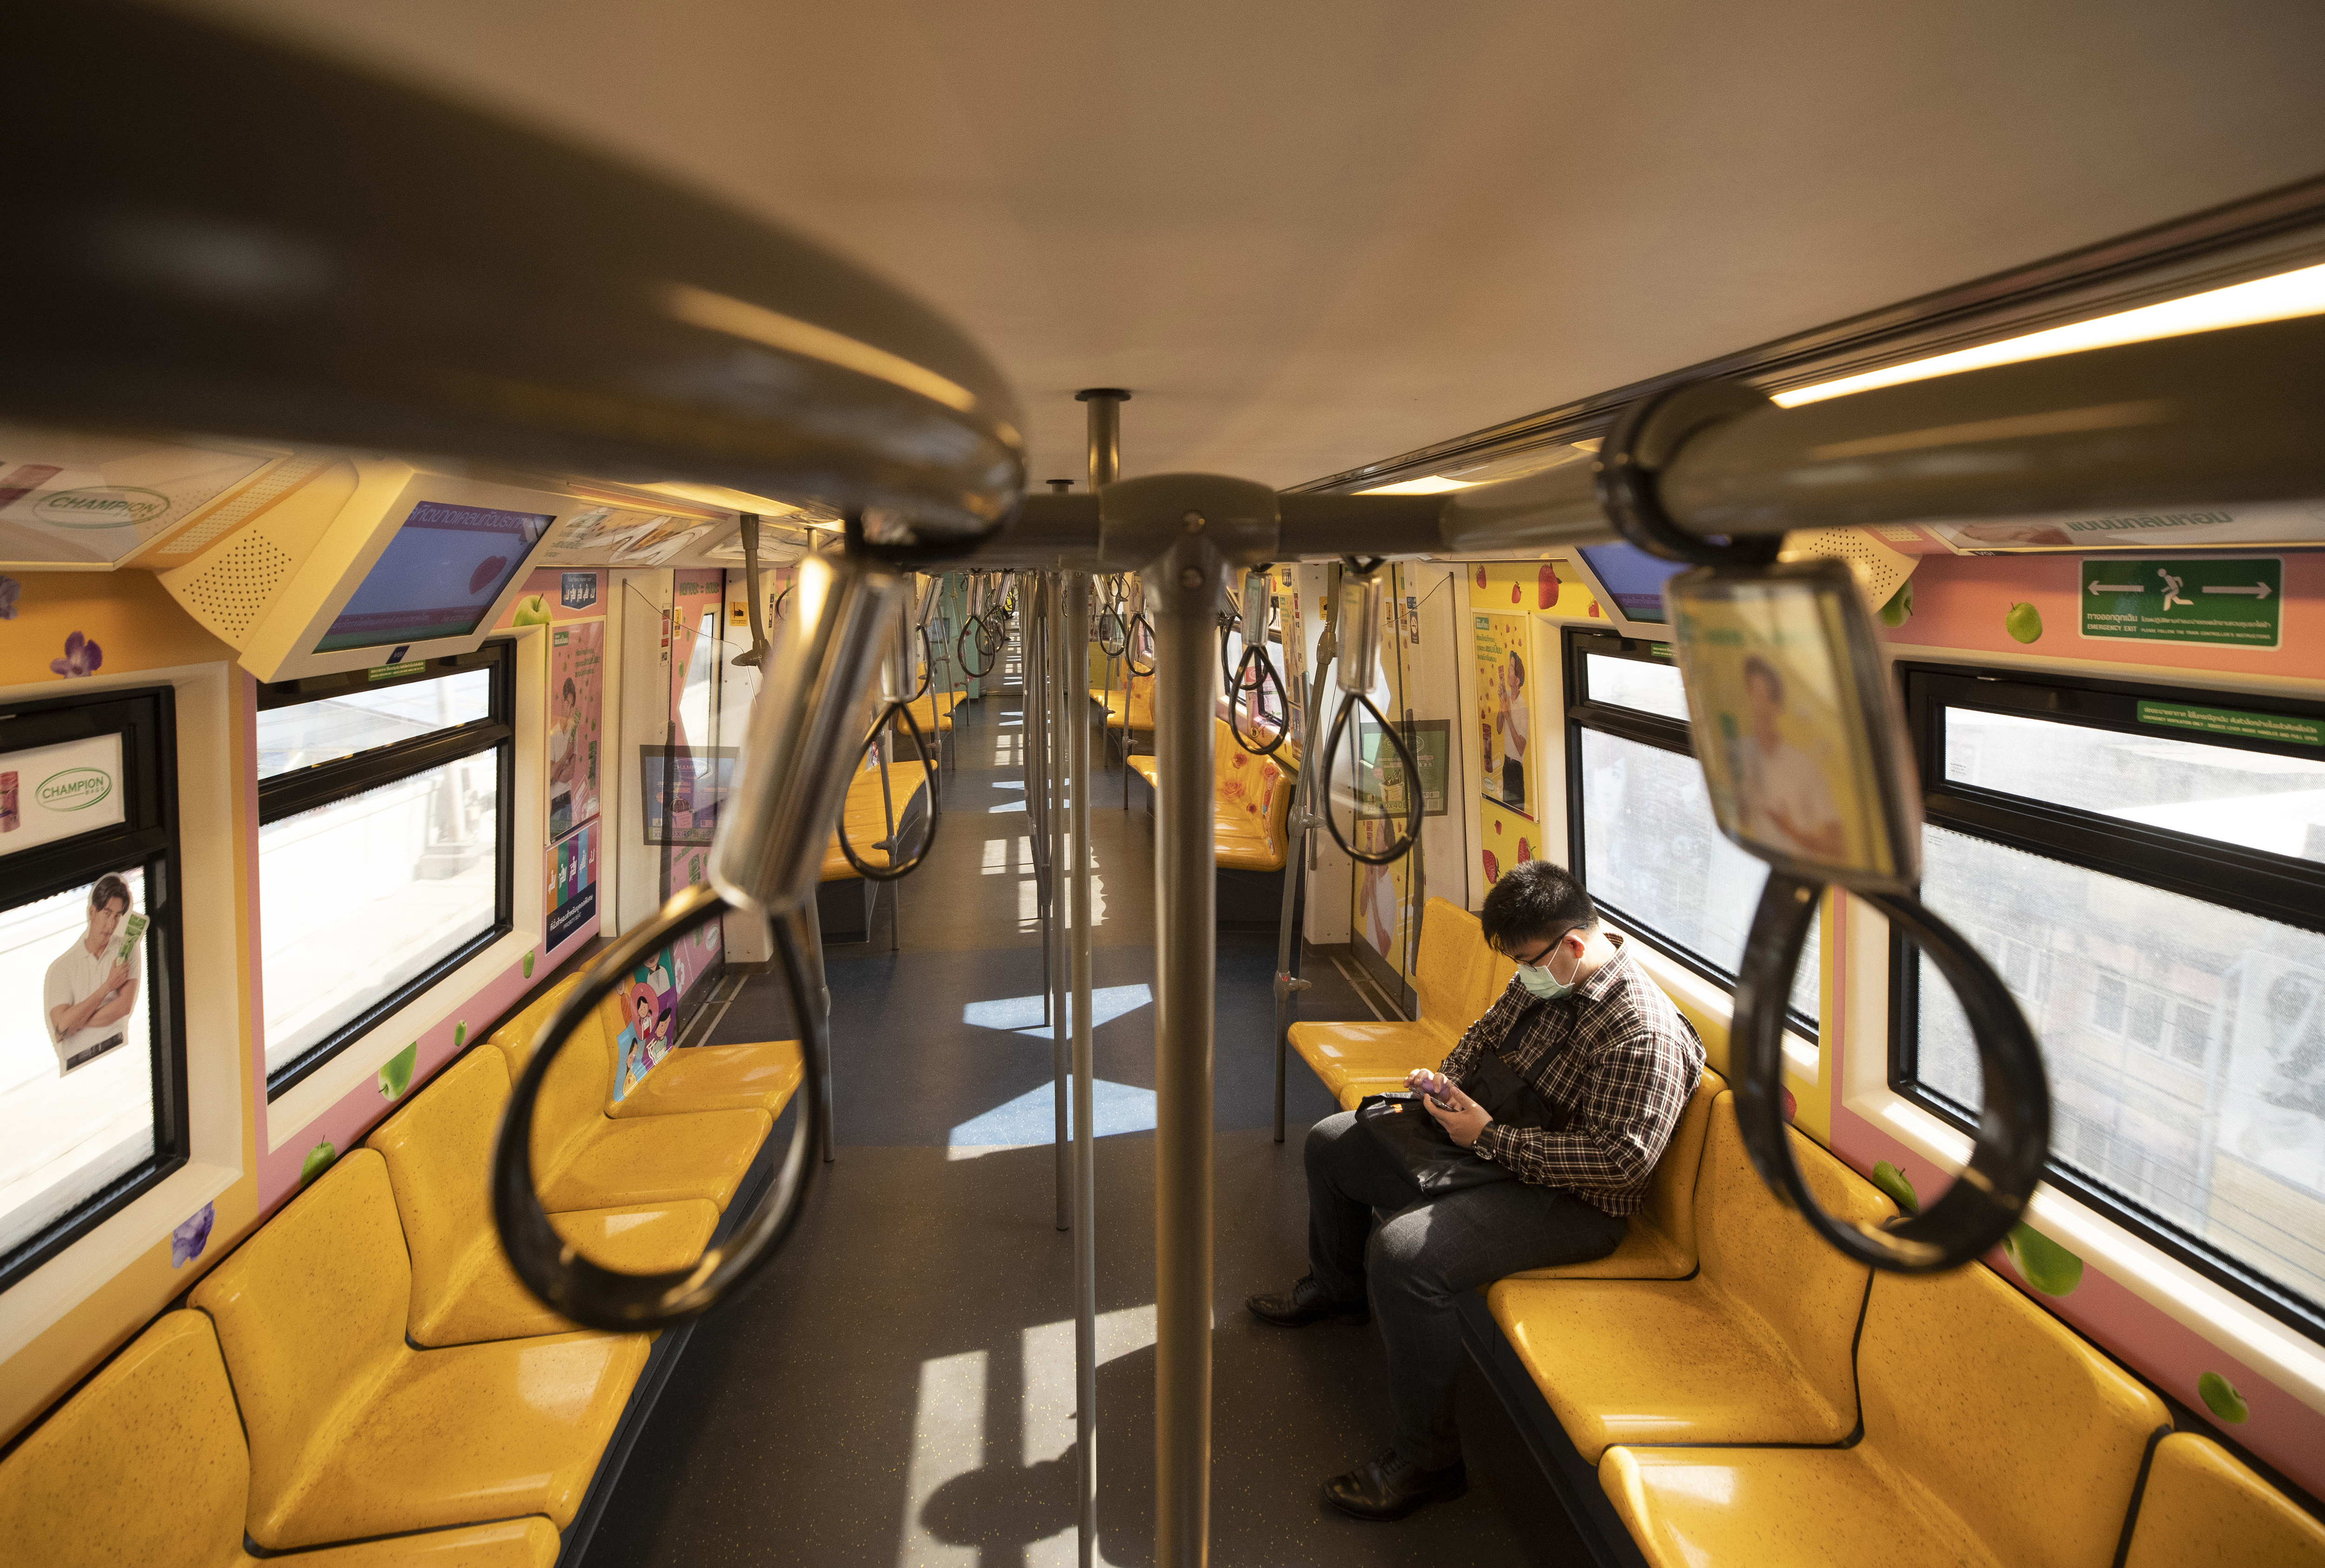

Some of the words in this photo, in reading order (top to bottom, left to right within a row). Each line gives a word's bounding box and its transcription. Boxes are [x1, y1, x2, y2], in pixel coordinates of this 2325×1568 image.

[49, 496, 160, 513] CHAMPION
[2087, 613, 2138, 623] ทางออกฉุกเฉิน
[42, 776, 103, 799] CHAMPION
[563, 917, 575, 929] PRIORITY
